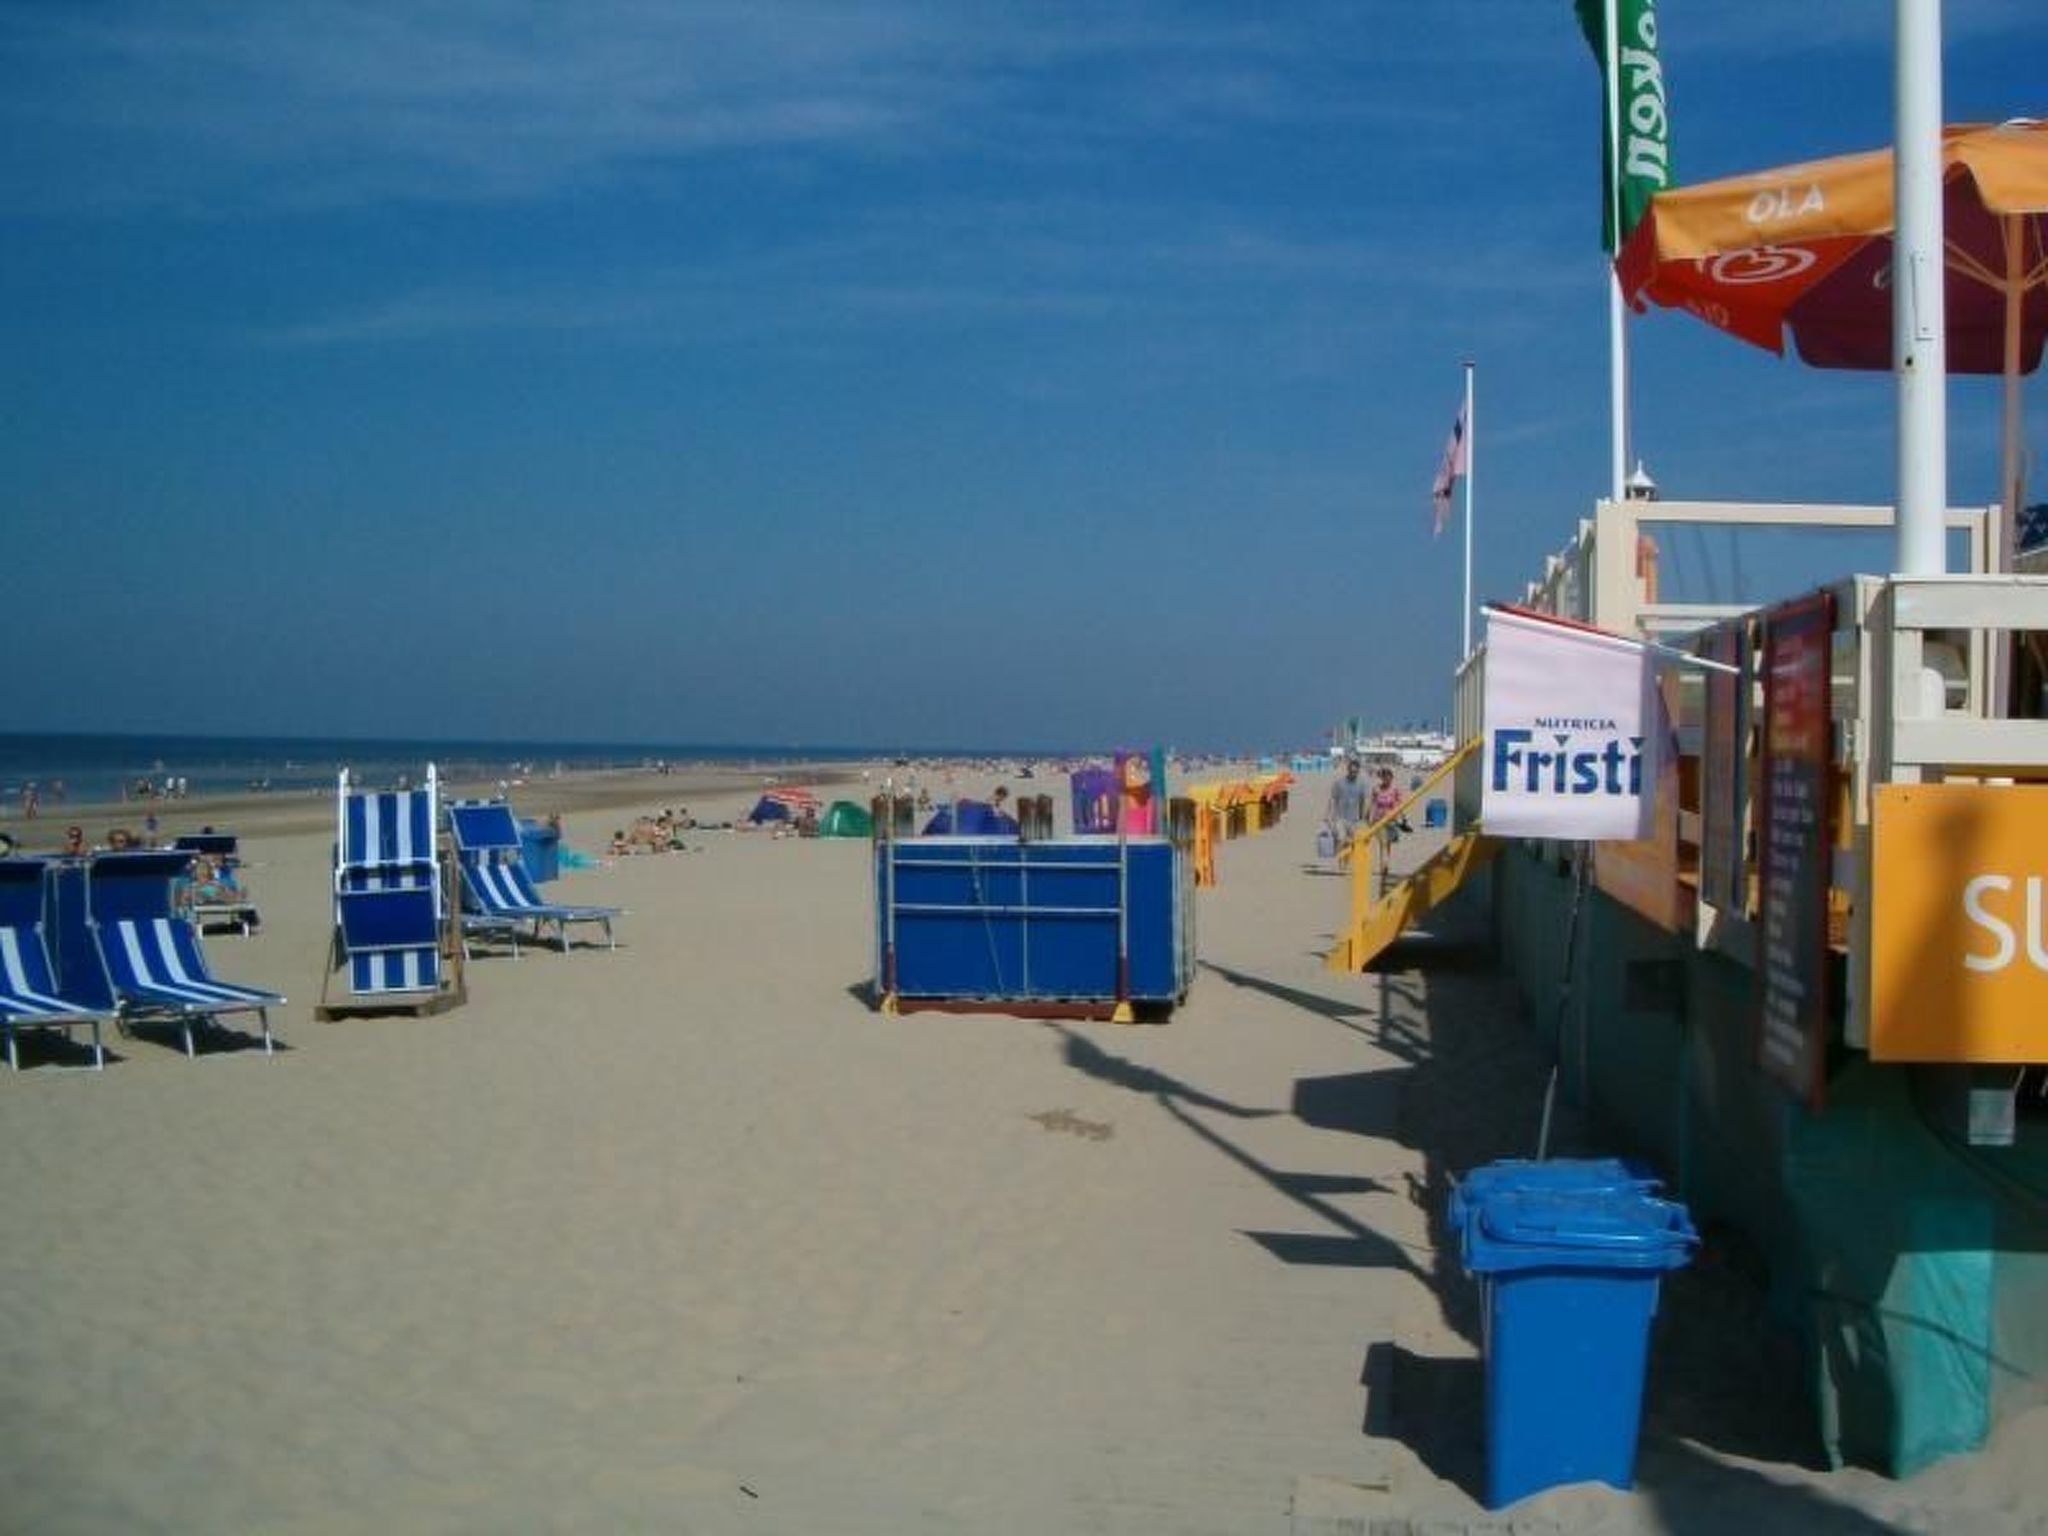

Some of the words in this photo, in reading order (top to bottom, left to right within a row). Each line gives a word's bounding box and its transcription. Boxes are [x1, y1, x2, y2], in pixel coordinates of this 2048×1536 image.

[1747, 184, 1825, 222] OLA
[1534, 717, 1617, 730] NUTRICIA
[1492, 729, 1646, 795] Fristi
